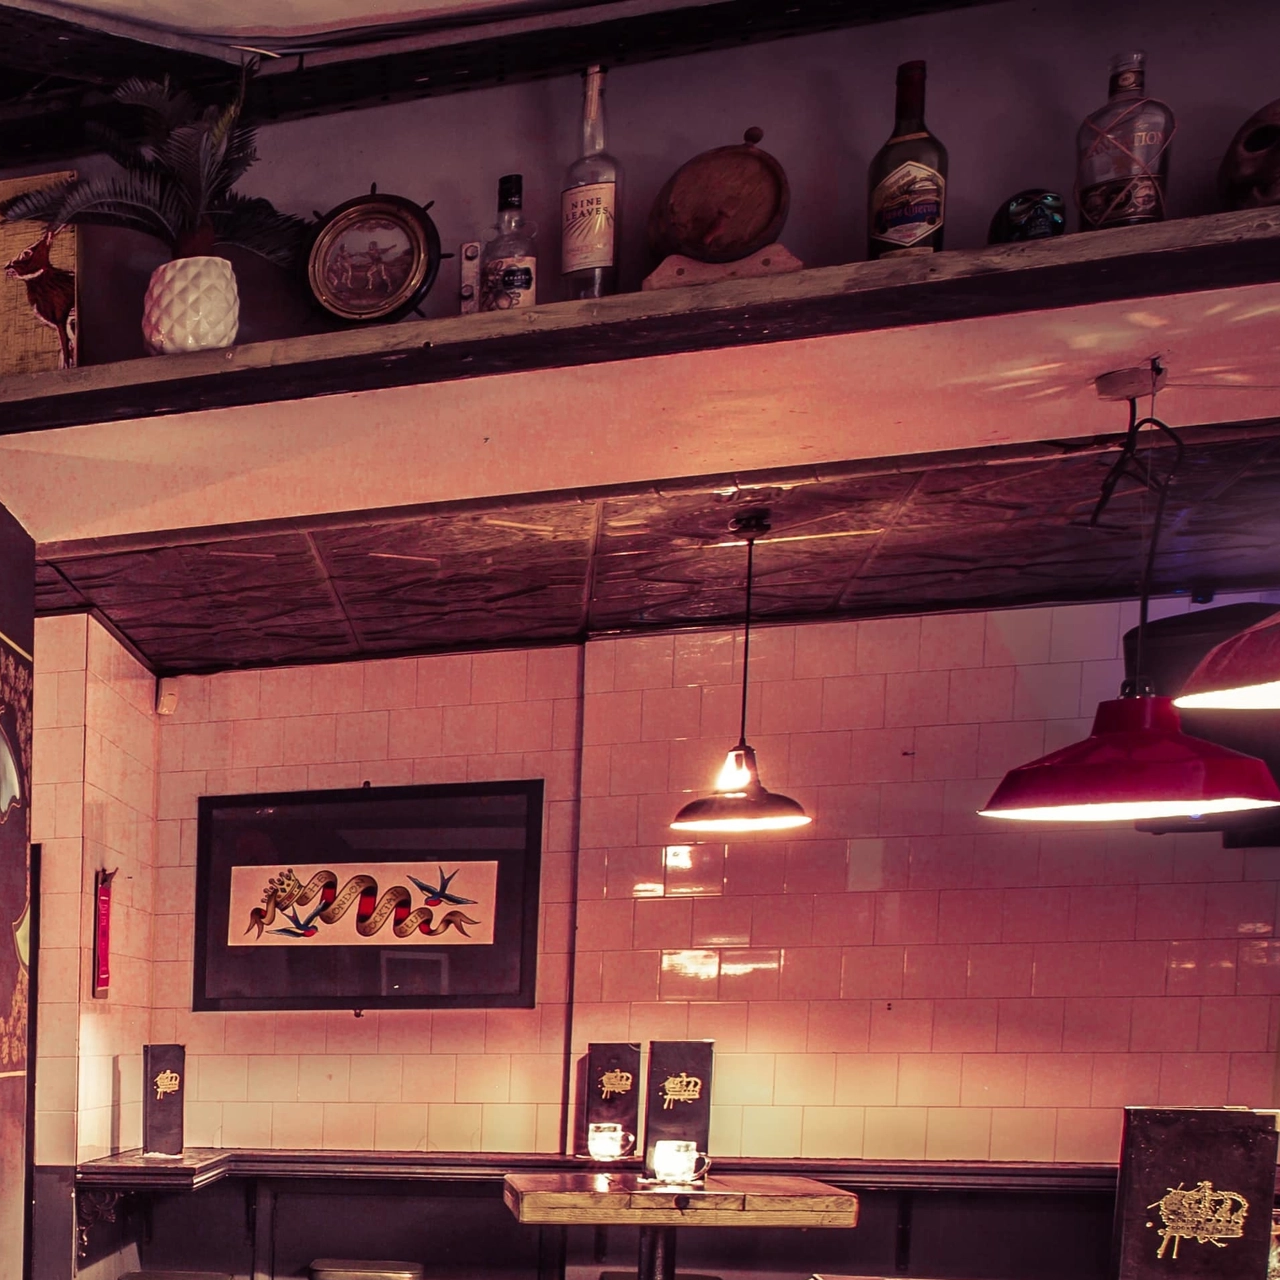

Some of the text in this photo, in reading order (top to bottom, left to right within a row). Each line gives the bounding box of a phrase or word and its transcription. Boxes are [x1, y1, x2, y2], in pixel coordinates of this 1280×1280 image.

[566, 207, 609, 222] LEAVES
[571, 197, 602, 210] NINE
[302, 873, 328, 901] THE
[325, 876, 367, 921] LONDON
[362, 888, 405, 935] COCKTAIL
[399, 909, 427, 935] CLUB
